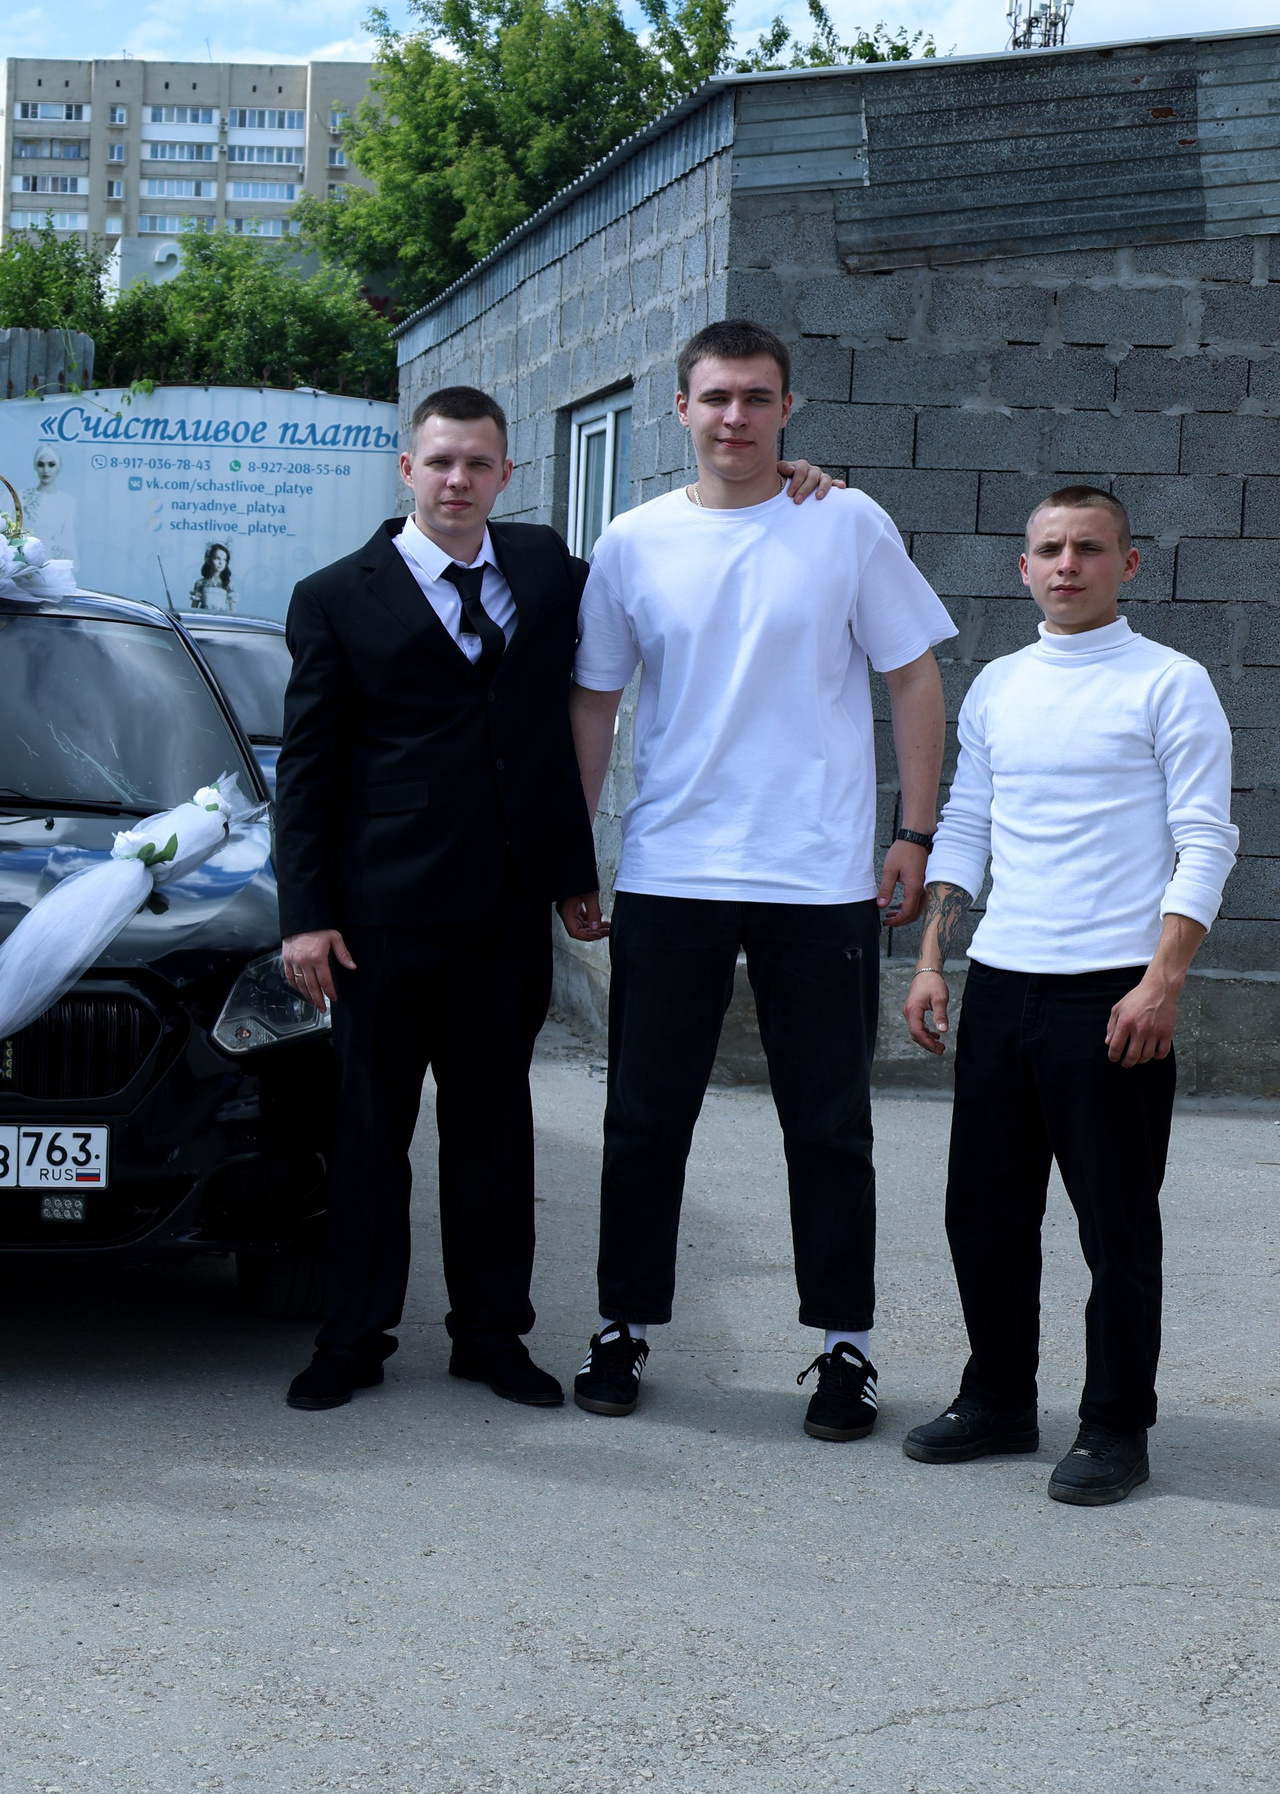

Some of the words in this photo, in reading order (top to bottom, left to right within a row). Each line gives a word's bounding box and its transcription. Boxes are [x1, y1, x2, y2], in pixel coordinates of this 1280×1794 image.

[39, 406, 267, 442] «Счастливое
[109, 456, 211, 471] 8-917-036-78-43
[247, 461, 351, 476] 8-927-208-55-68
[146, 477, 314, 496] vk.com/schastlivoe_platye
[171, 499, 286, 517] naryadnye_platya
[169, 518, 297, 537] schastlivoe_platye_
[22, 1131, 93, 1167] 763
[39, 1168, 74, 1181] RUS
